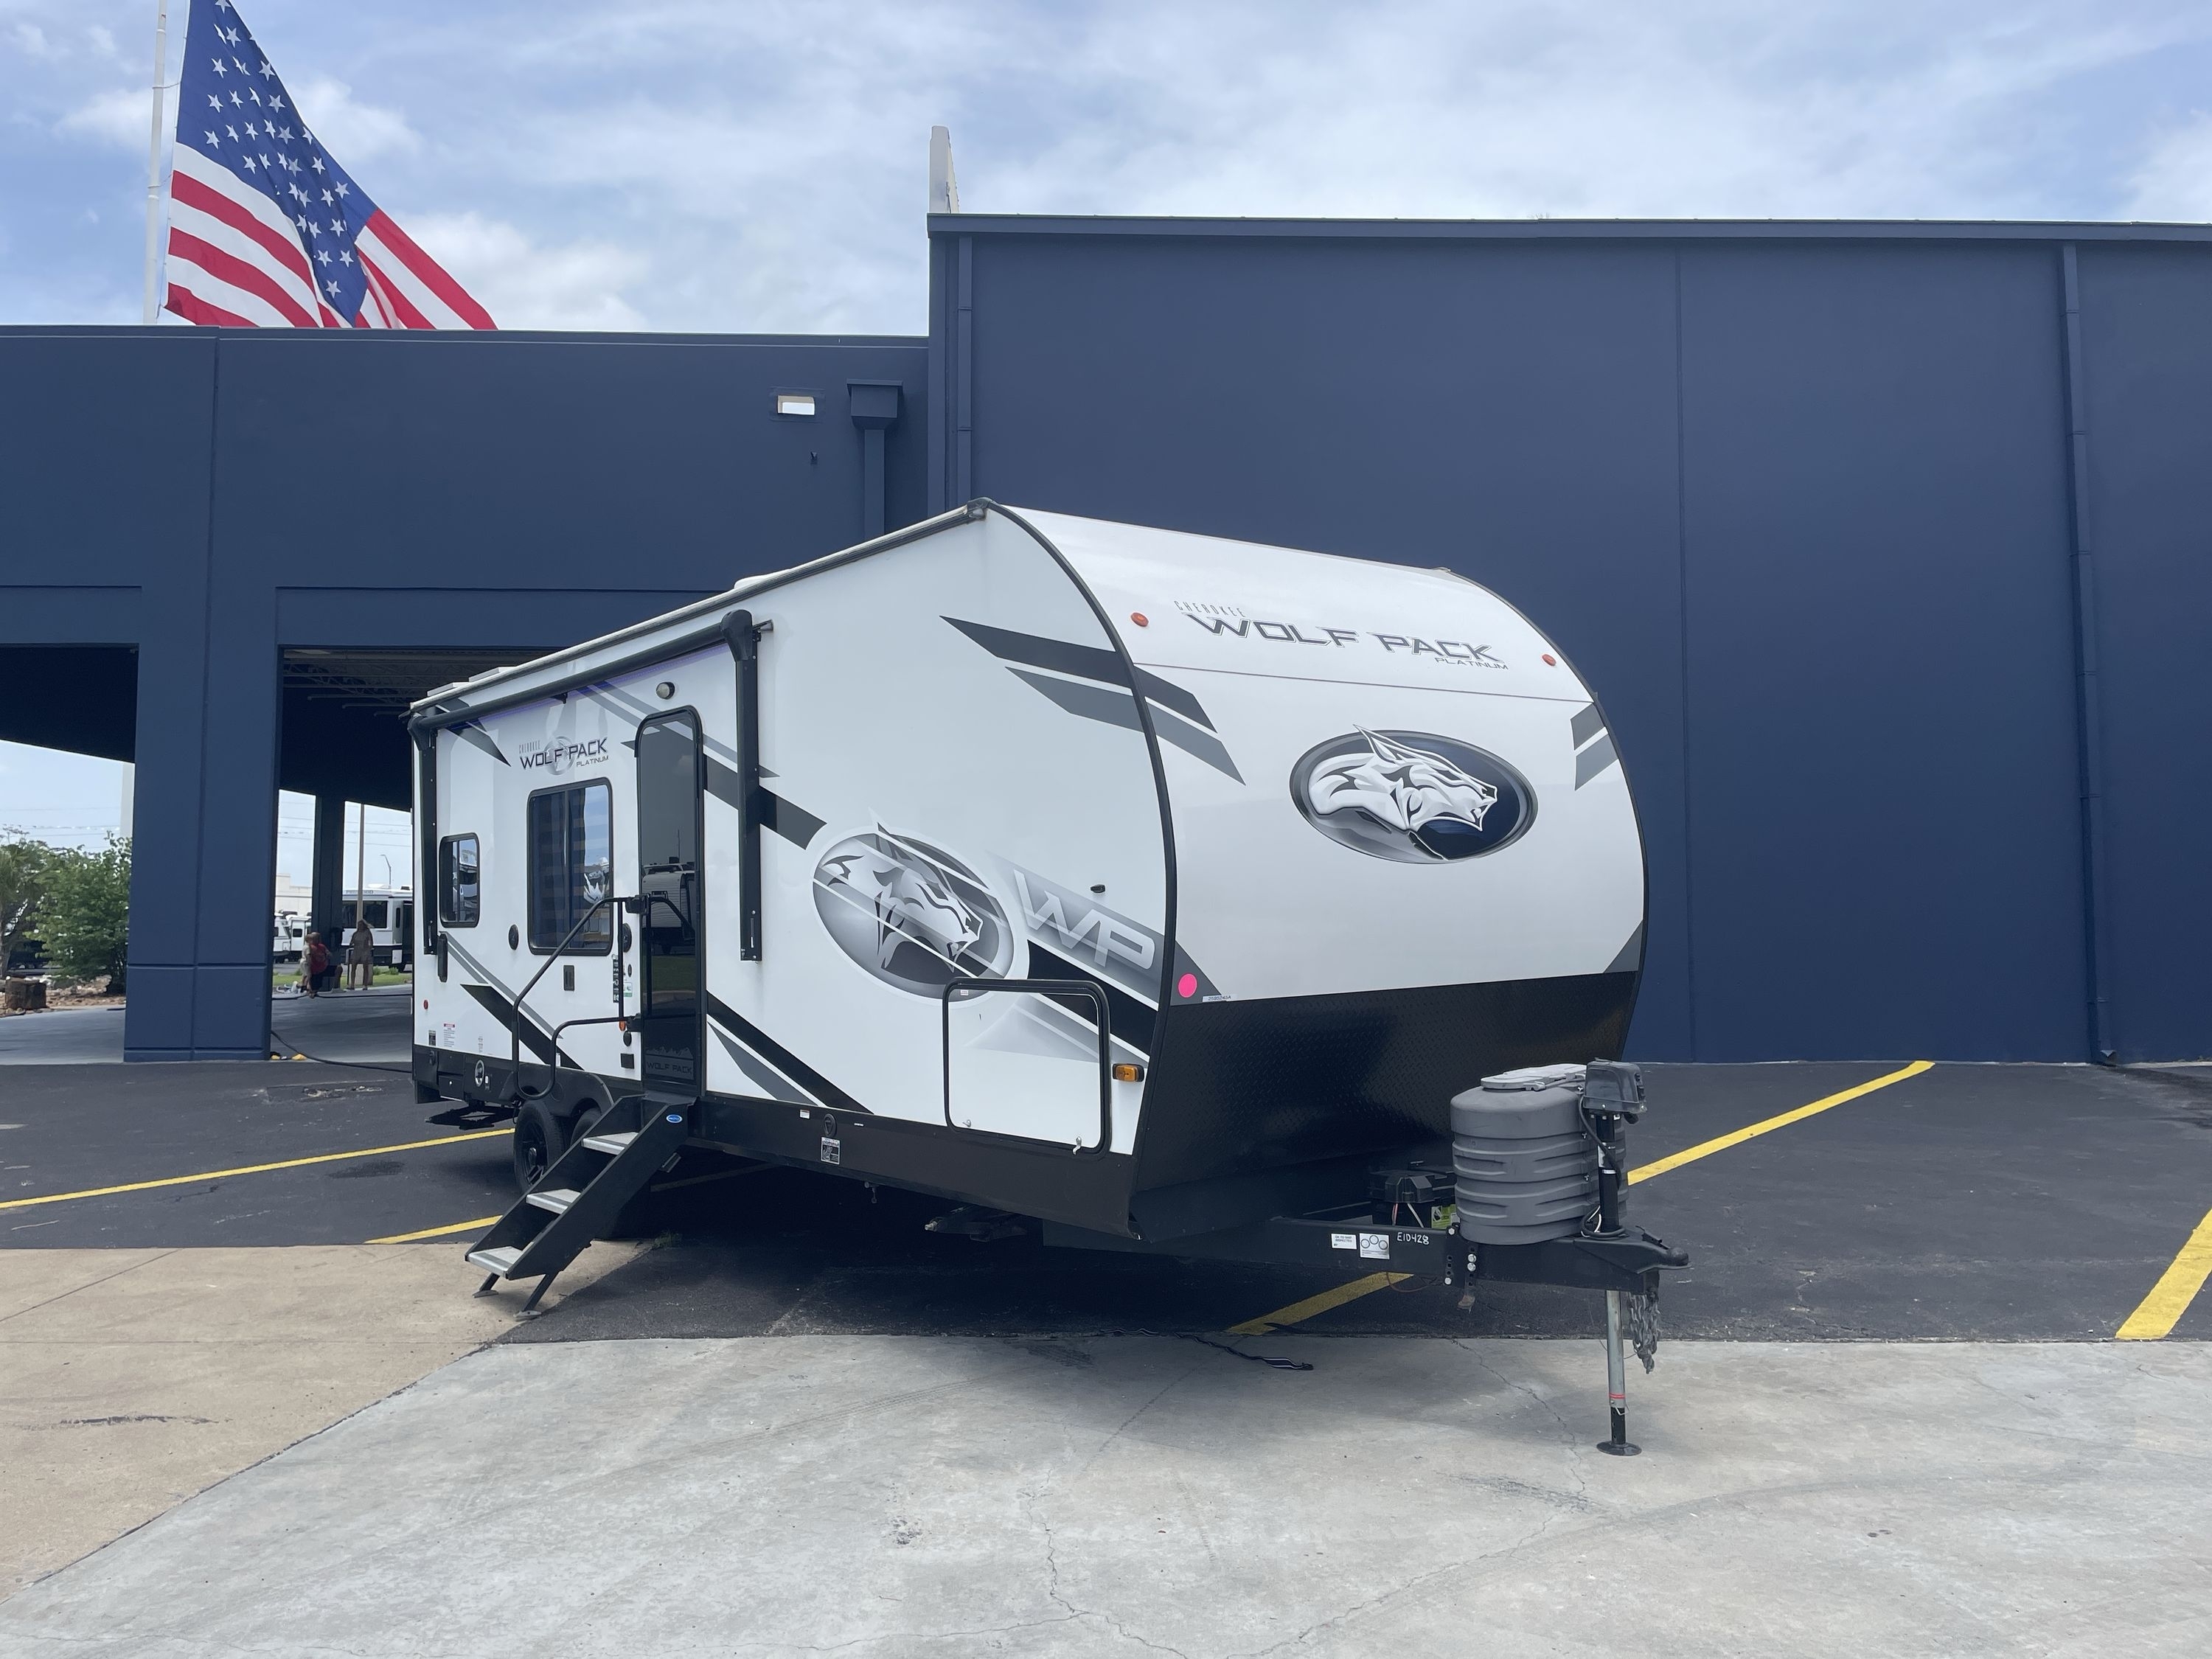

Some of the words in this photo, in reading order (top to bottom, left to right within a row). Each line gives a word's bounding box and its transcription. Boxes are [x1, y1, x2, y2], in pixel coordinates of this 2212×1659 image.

[1174, 600, 1246, 618] CHEROKEE
[1181, 611, 1360, 648] WOLF
[1366, 631, 1506, 664] PACK
[1435, 657, 1509, 670] PLATINUM
[519, 748, 564, 770] WOLF
[568, 737, 608, 760] PACK
[576, 755, 609, 768] PLATINUM
[1013, 869, 1155, 970] WP
[647, 1061, 670, 1071] WOLF
[672, 1064, 694, 1074] PACK
